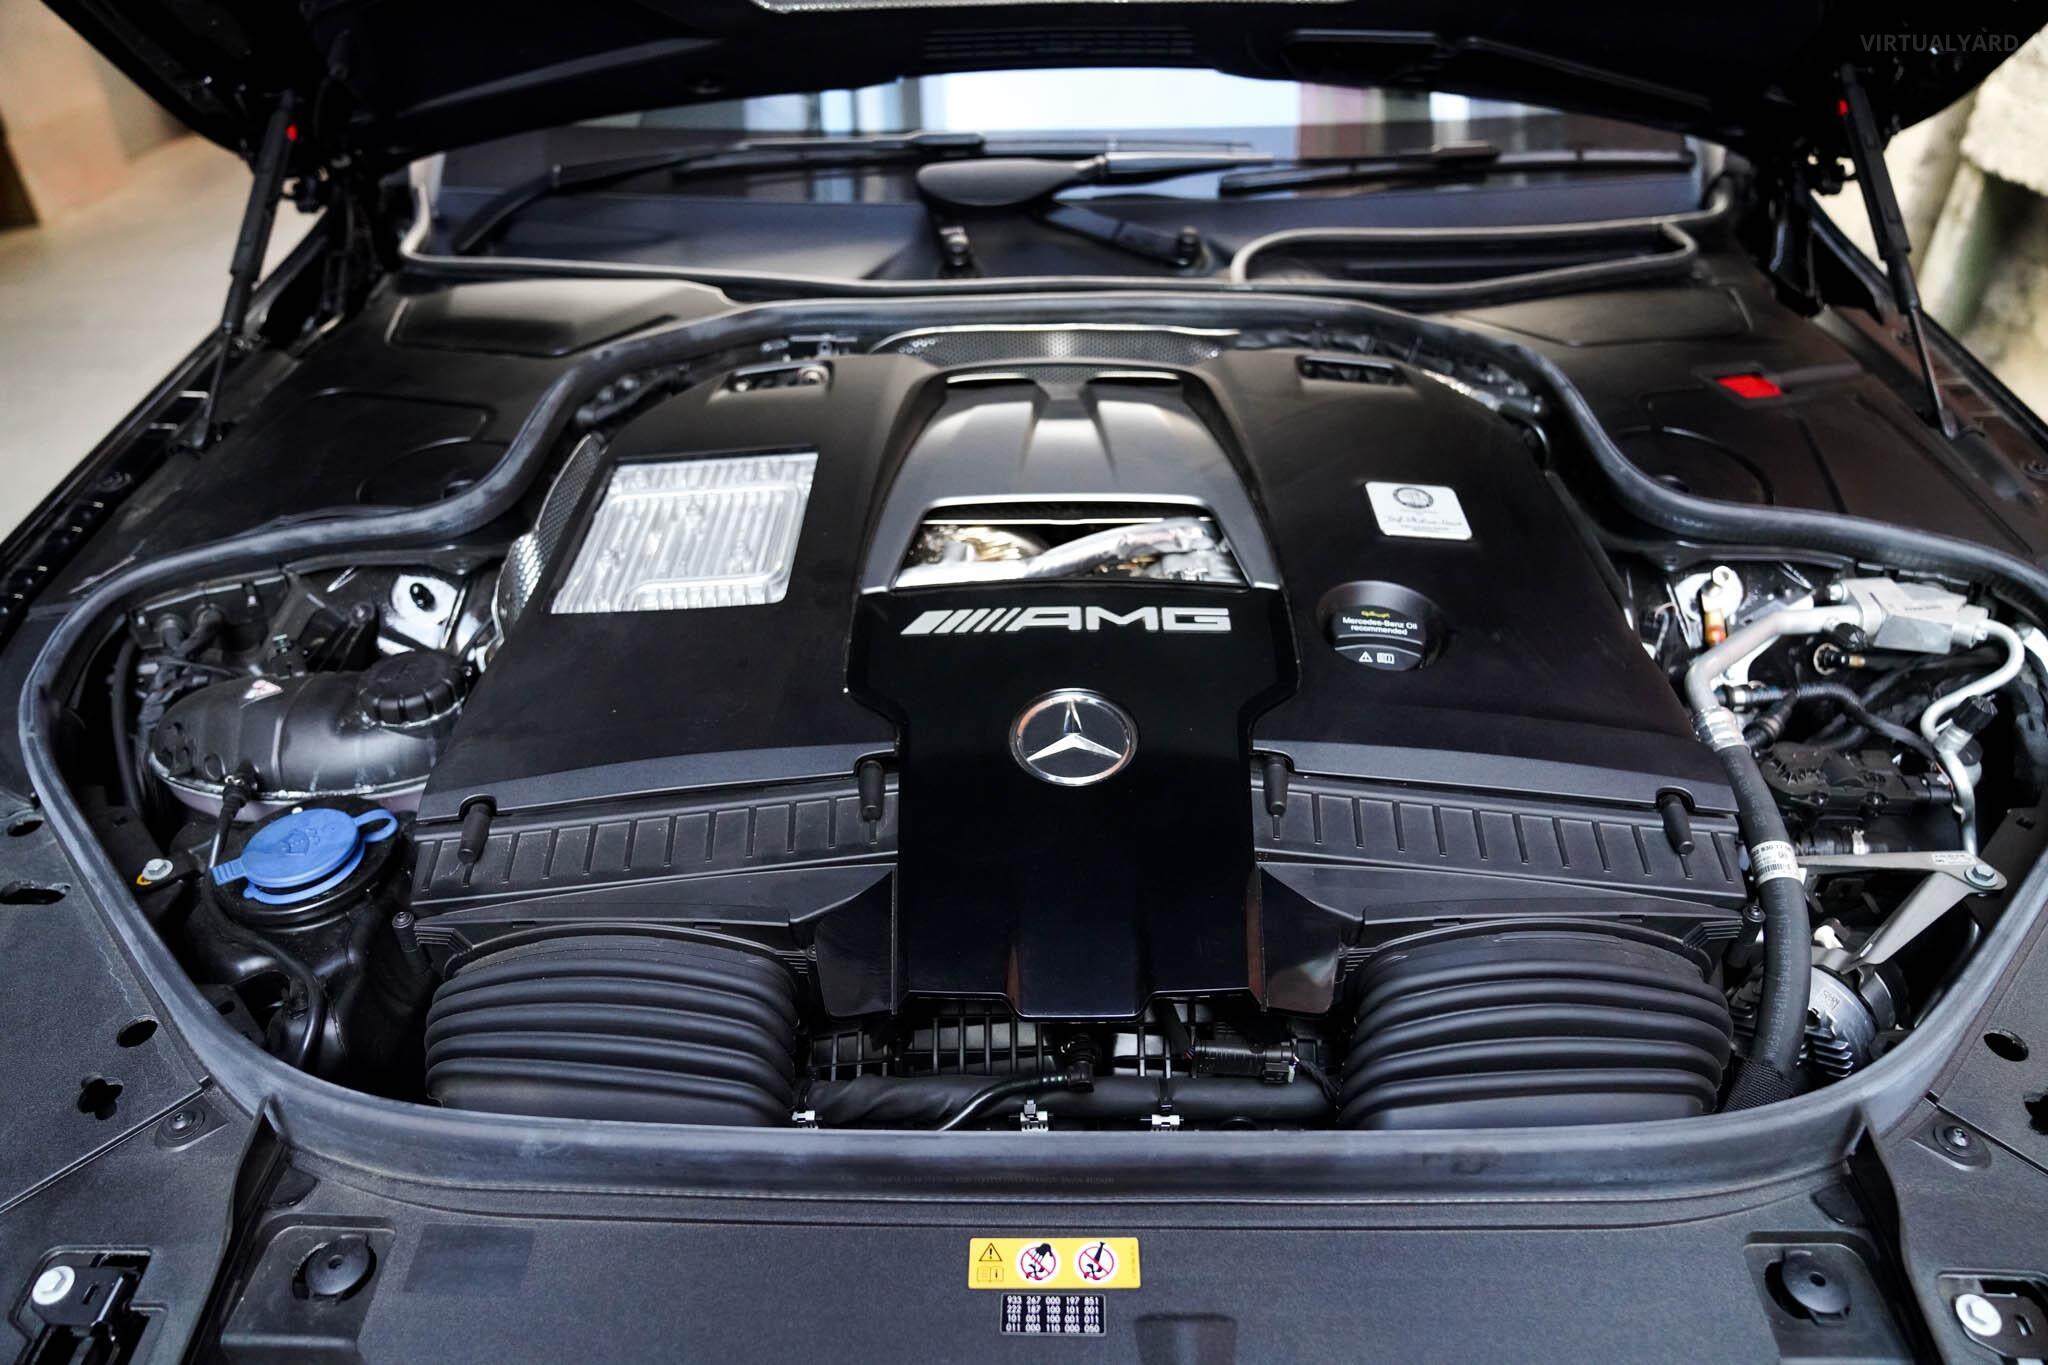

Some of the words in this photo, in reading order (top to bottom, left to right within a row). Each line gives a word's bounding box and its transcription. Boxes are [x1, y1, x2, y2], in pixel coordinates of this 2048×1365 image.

[1005, 606, 1232, 632] AMG
[1342, 616, 1405, 629] Mercedes-Benz
[1406, 622, 1418, 630] Oil
[1350, 625, 1408, 636] recommended
[1045, 1295, 1061, 1305] 000
[1066, 1295, 1080, 1305] 197
[1007, 1305, 1022, 1314] 222
[1046, 1305, 1061, 1314] 100
[1066, 1305, 1079, 1314] 101
[1084, 1305, 1099, 1314] 001
[1007, 1314, 1021, 1323] 101
[1025, 1314, 1040, 1323] 001
[1046, 1314, 1061, 1323] 100
[1064, 1314, 1079, 1323] 001
[1084, 1314, 1099, 1323] 011
[1005, 1323, 1021, 1333] 011
[1025, 1323, 1041, 1333] 000
[1046, 1323, 1061, 1333] 110
[1064, 1323, 1080, 1333] 000
